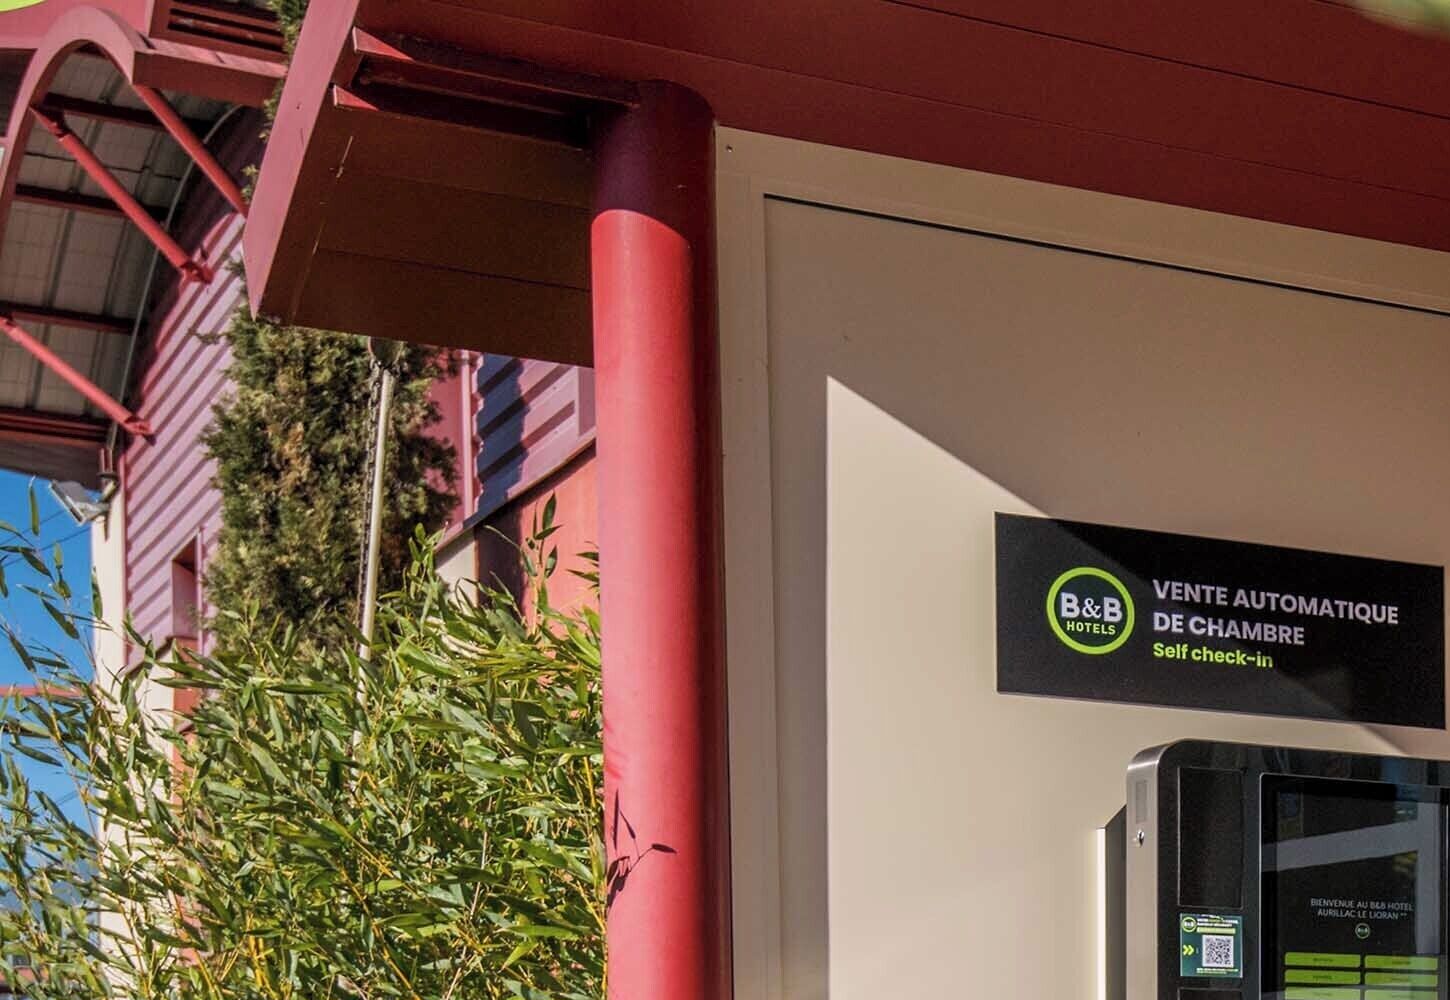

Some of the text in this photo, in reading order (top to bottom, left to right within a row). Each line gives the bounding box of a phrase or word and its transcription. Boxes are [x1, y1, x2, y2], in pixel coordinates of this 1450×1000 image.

[1060, 592, 1122, 622] B&B
[1152, 578, 1399, 625] VENTE AUTOMATIQUE
[1066, 620, 1116, 636] HOTELS
[1153, 614, 1305, 646] DE CHAMBRE
[1153, 642, 1273, 669] Self check-in
[1310, 898, 1354, 908] BIENVENUE
[1357, 901, 1368, 909] AU
[1388, 903, 1414, 912] HOTEL
[1317, 909, 1356, 918] AURILLAC
